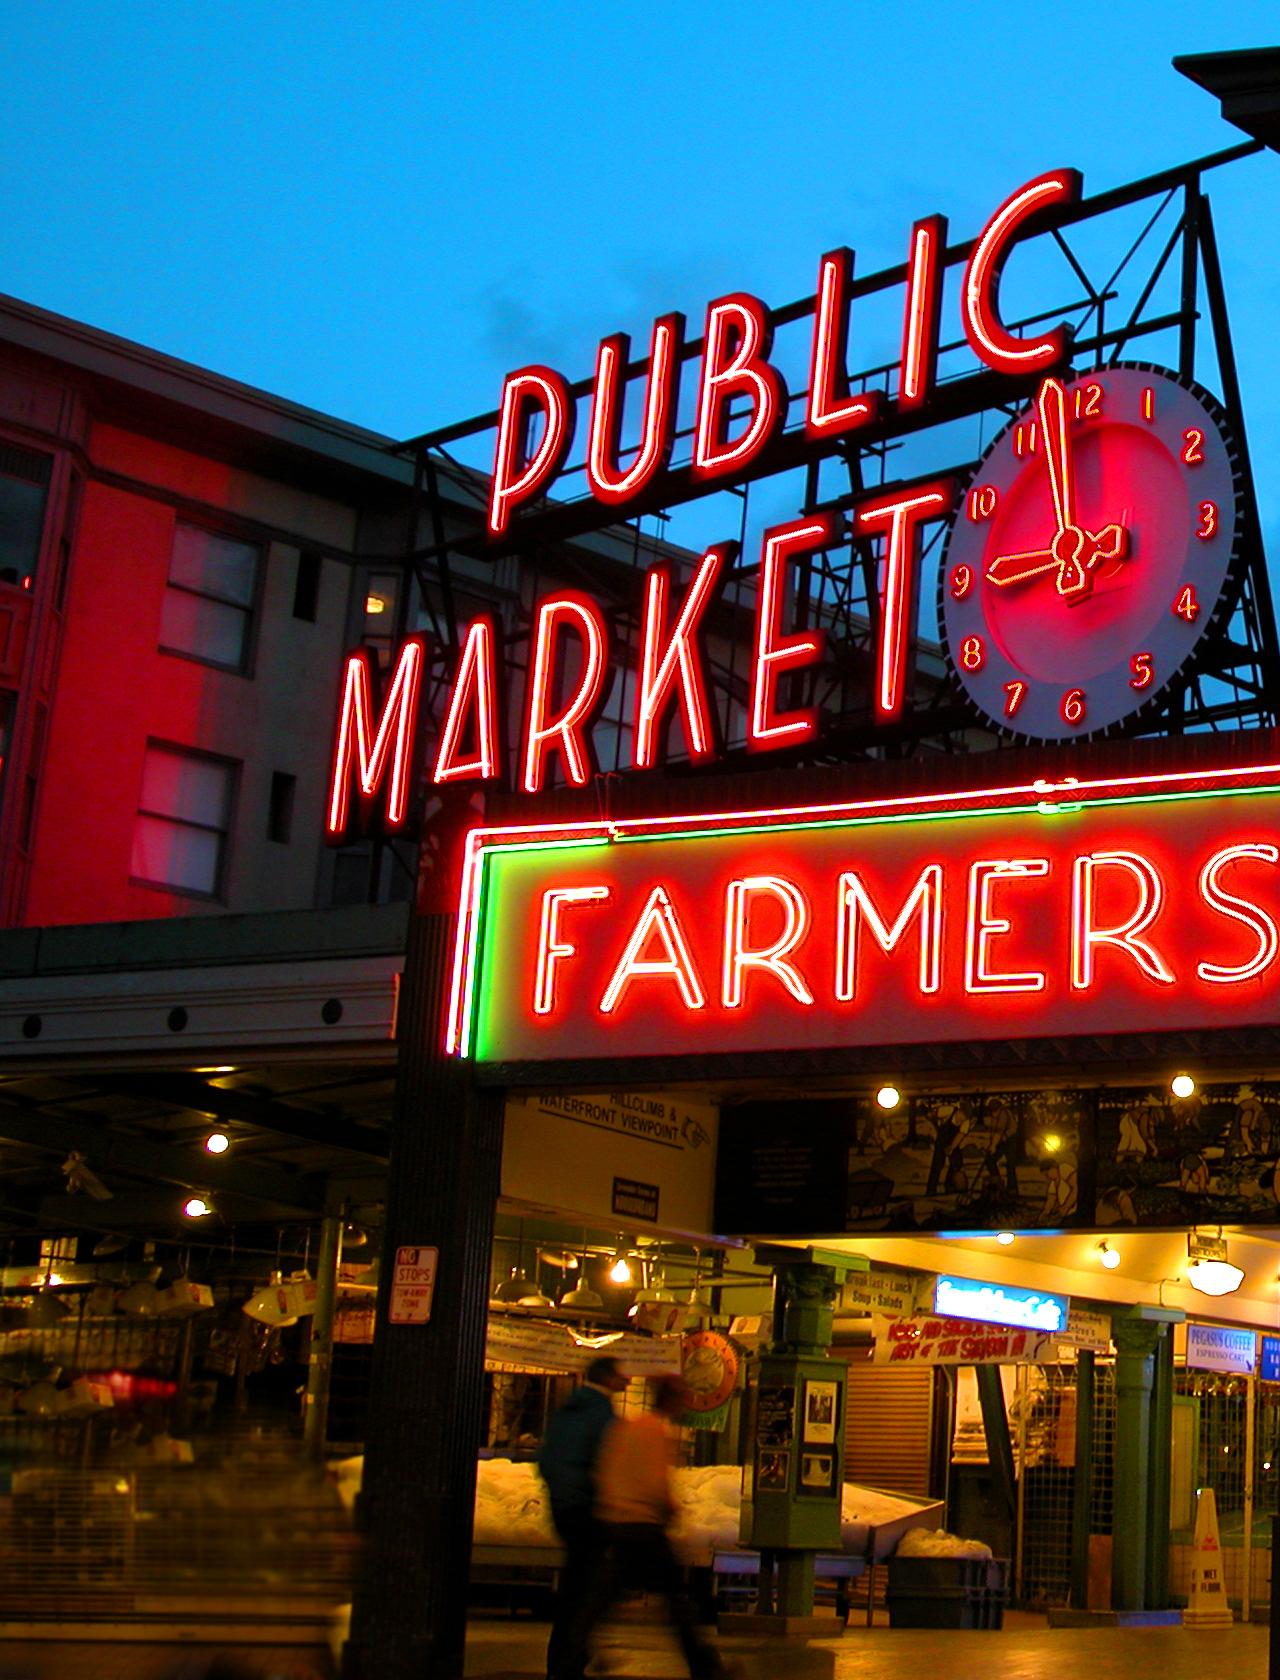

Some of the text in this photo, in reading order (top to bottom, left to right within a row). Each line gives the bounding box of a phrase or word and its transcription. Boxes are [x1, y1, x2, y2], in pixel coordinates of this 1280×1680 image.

[487, 170, 1080, 534] PUBLIC
[1074, 382, 1103, 421] 12
[1016, 421, 1038, 456] 11
[1184, 428, 1203, 463] 2
[969, 486, 998, 522] 10
[1196, 502, 1217, 537] 3
[950, 564, 973, 598] 9
[1175, 585, 1199, 621] 4
[328, 484, 952, 834] MARKET
[961, 635, 985, 670] 8
[1131, 653, 1153, 688] 5
[1004, 680, 1026, 716] 7
[1062, 689, 1085, 723] 6
[539, 1095, 679, 1140] WATERFRONT VIEWPOINT
[609, 1091, 664, 1118] HILLCLIMB
[399, 1248, 417, 1264] NO
[399, 1267, 431, 1281] STOPS
[1191, 1328, 1252, 1351] PEGASUS COFFEE
[1196, 1348, 1245, 1362] ESPRESSO CART
[1204, 1569, 1216, 1579] WET
